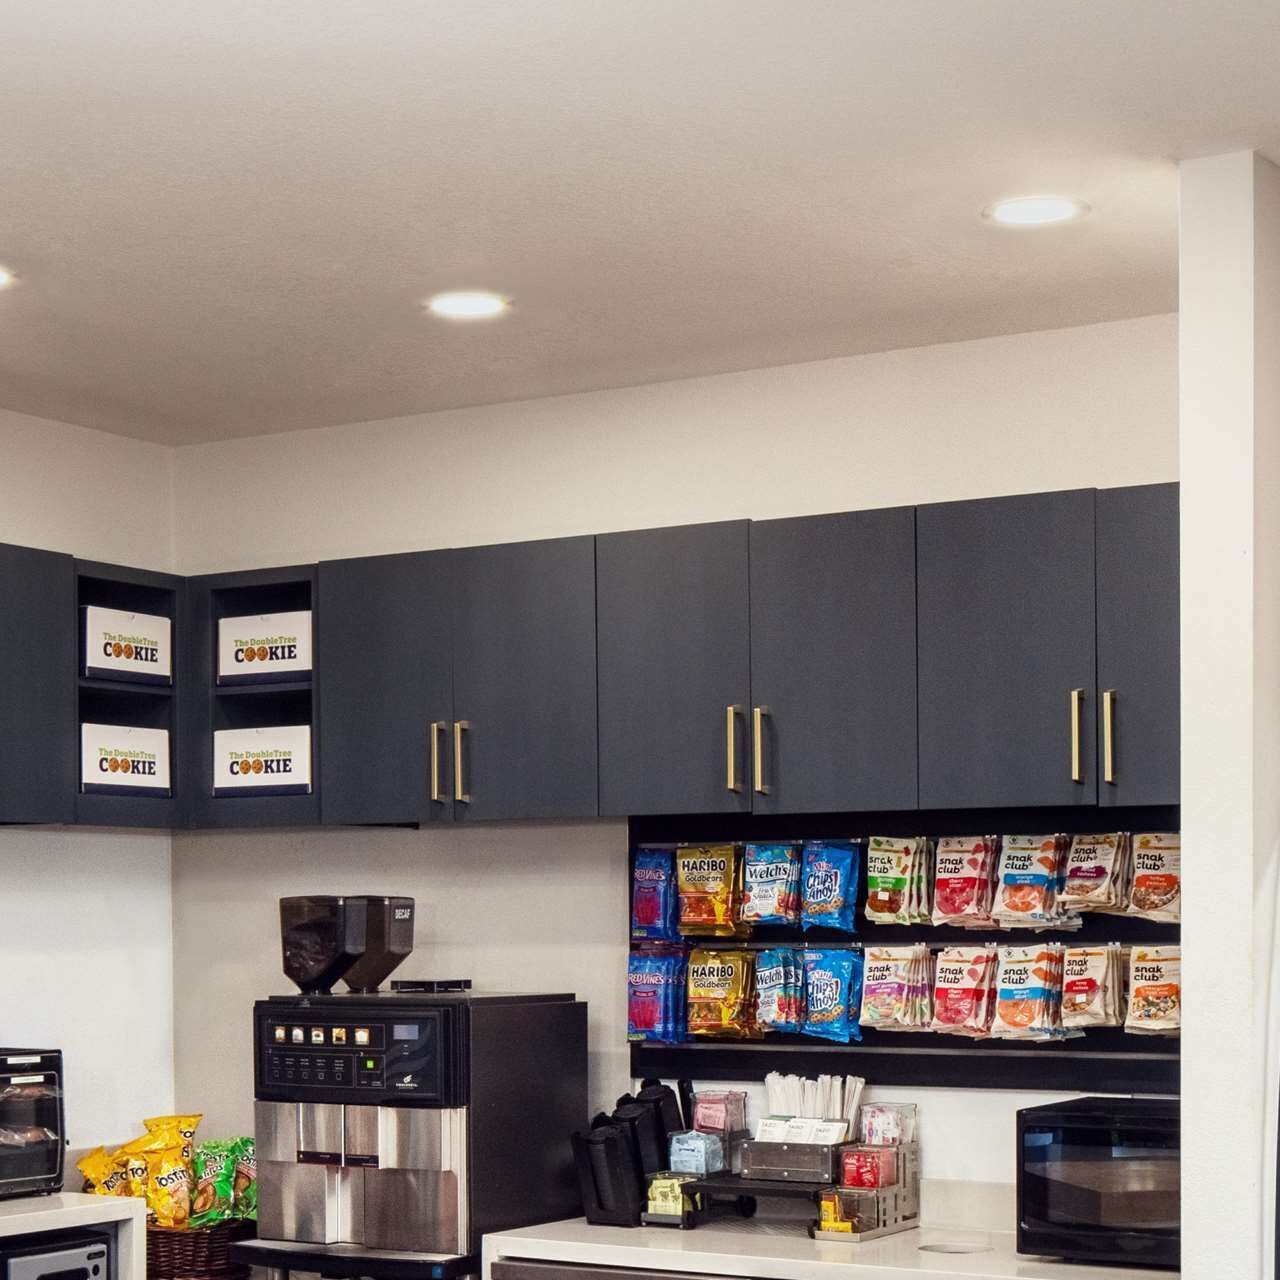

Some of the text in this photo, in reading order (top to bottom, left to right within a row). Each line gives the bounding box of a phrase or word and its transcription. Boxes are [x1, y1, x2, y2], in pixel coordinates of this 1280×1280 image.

[103, 632, 158, 647] The DoubleTree
[234, 636, 296, 648] The DoubleTree
[99, 748, 156, 760] The DoubleTree
[230, 750, 292, 760] The DoubleTree
[1074, 847, 1098, 855] snak
[869, 856, 893, 865] snak
[939, 856, 964, 865] snak
[1007, 854, 1033, 863] snak
[1137, 853, 1165, 862] snak
[682, 859, 726, 872] HARIBO
[749, 864, 789, 880] Welch's
[685, 874, 723, 883] Goldbears
[1067, 958, 1088, 967] snak
[692, 965, 734, 978] HARIBO
[869, 964, 892, 973] snak
[939, 967, 964, 976] snak
[1003, 967, 1029, 976] snak
[1135, 965, 1163, 974] snak
[694, 980, 732, 988] Goldbears
